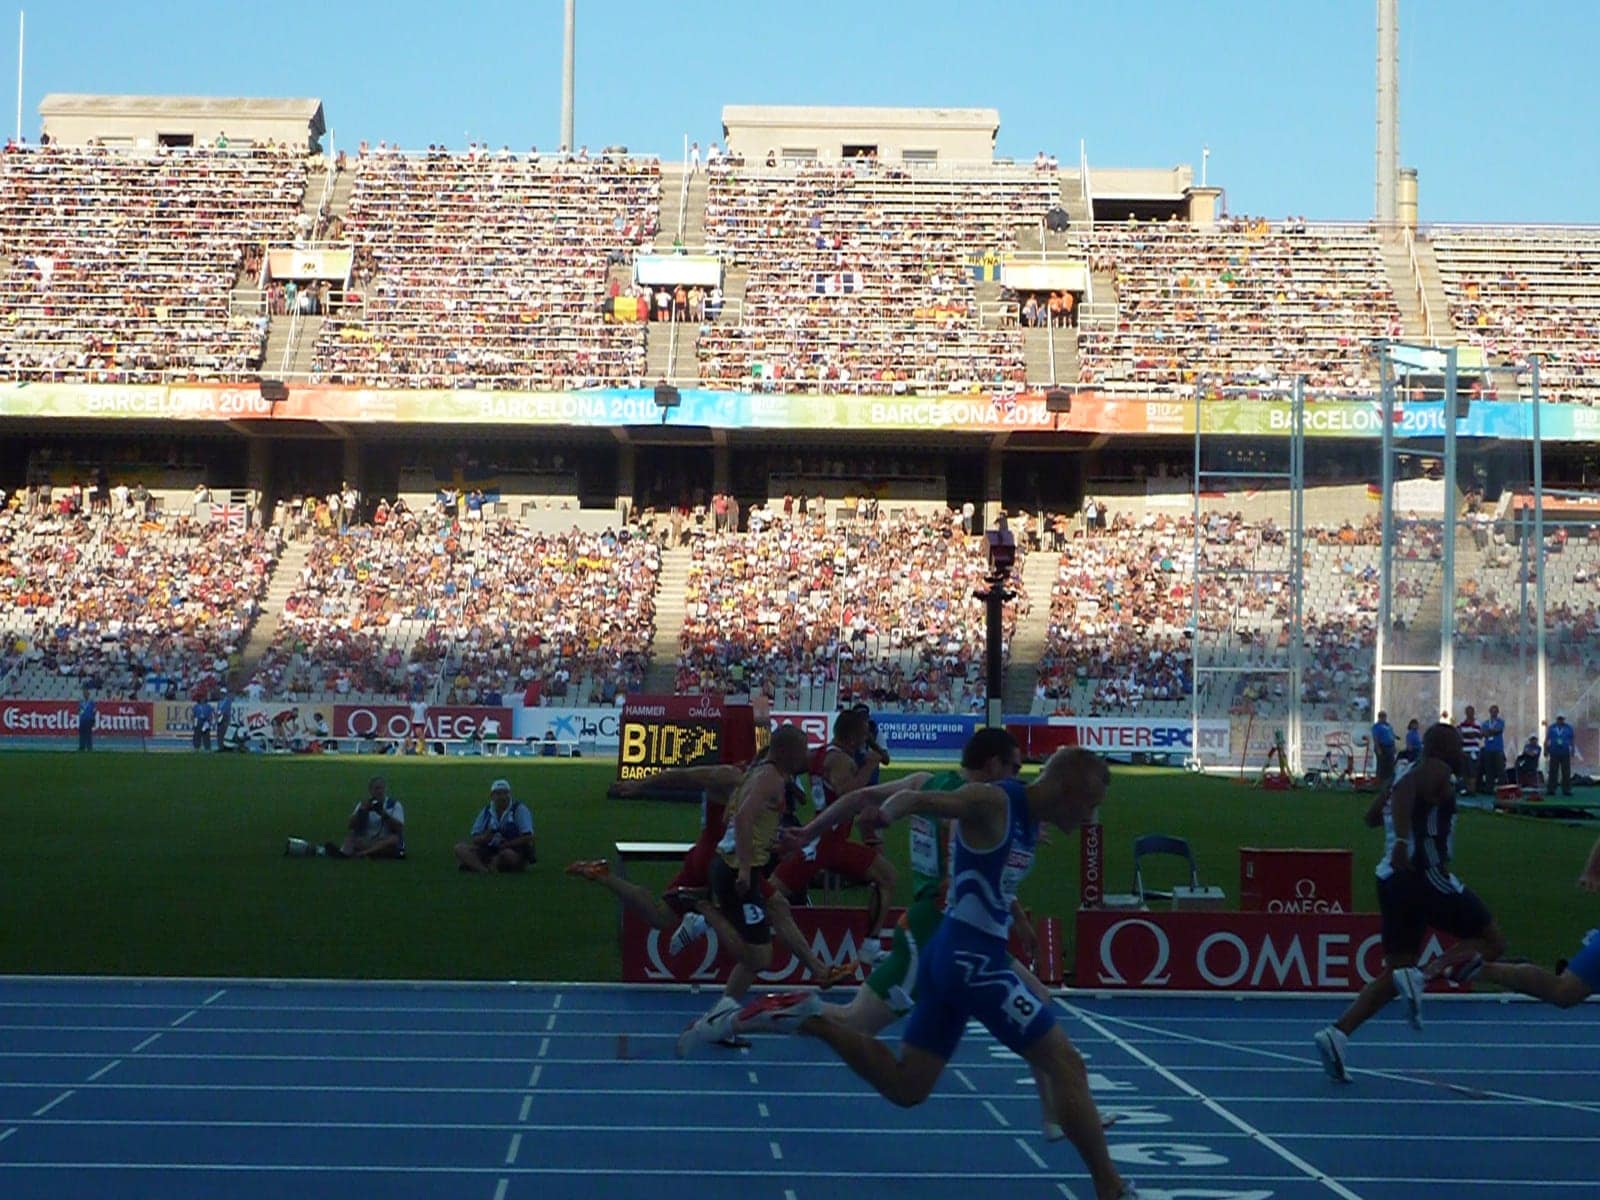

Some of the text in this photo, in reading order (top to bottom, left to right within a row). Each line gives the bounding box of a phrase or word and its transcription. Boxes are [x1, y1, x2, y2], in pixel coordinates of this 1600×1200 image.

[88, 389, 268, 413] BARCELONA 2010
[481, 396, 659, 420] BARCELONA 2010
[871, 402, 1050, 427] BARCELONA 2010
[1270, 407, 1393, 430] BARCELON
[3, 706, 80, 730] Estrella
[625, 705, 666, 717] HAMMER
[688, 707, 722, 718] OMEGA
[878, 723, 963, 733] CONSEJO SUPERIOR
[891, 732, 937, 741] DEPORTES
[1079, 726, 1228, 748] INTERSPORT
[1086, 824, 1099, 882] OMEGA
[750, 905, 760, 921] 3
[1267, 898, 1345, 914] OMEGA
[1013, 994, 1035, 1017] 8
